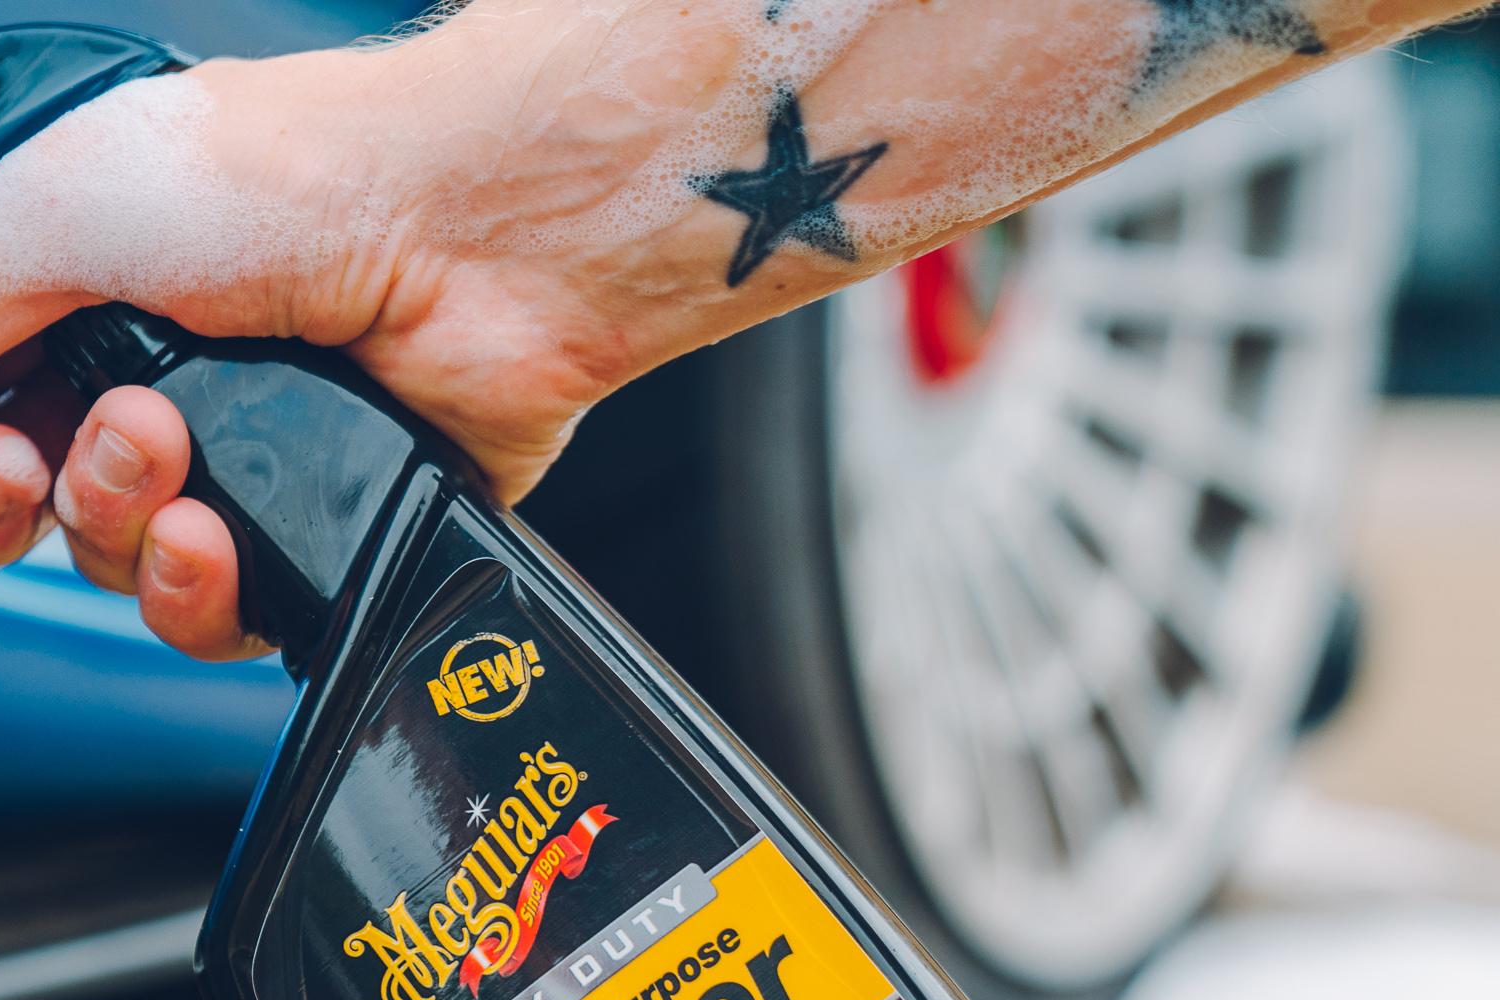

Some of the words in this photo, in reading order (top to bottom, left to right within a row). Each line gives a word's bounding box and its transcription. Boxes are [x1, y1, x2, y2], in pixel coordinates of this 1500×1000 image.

[426, 639, 545, 716] NEW!
[520, 879, 544, 928] Since
[534, 842, 566, 880] 1901
[569, 885, 688, 986] DUTY
